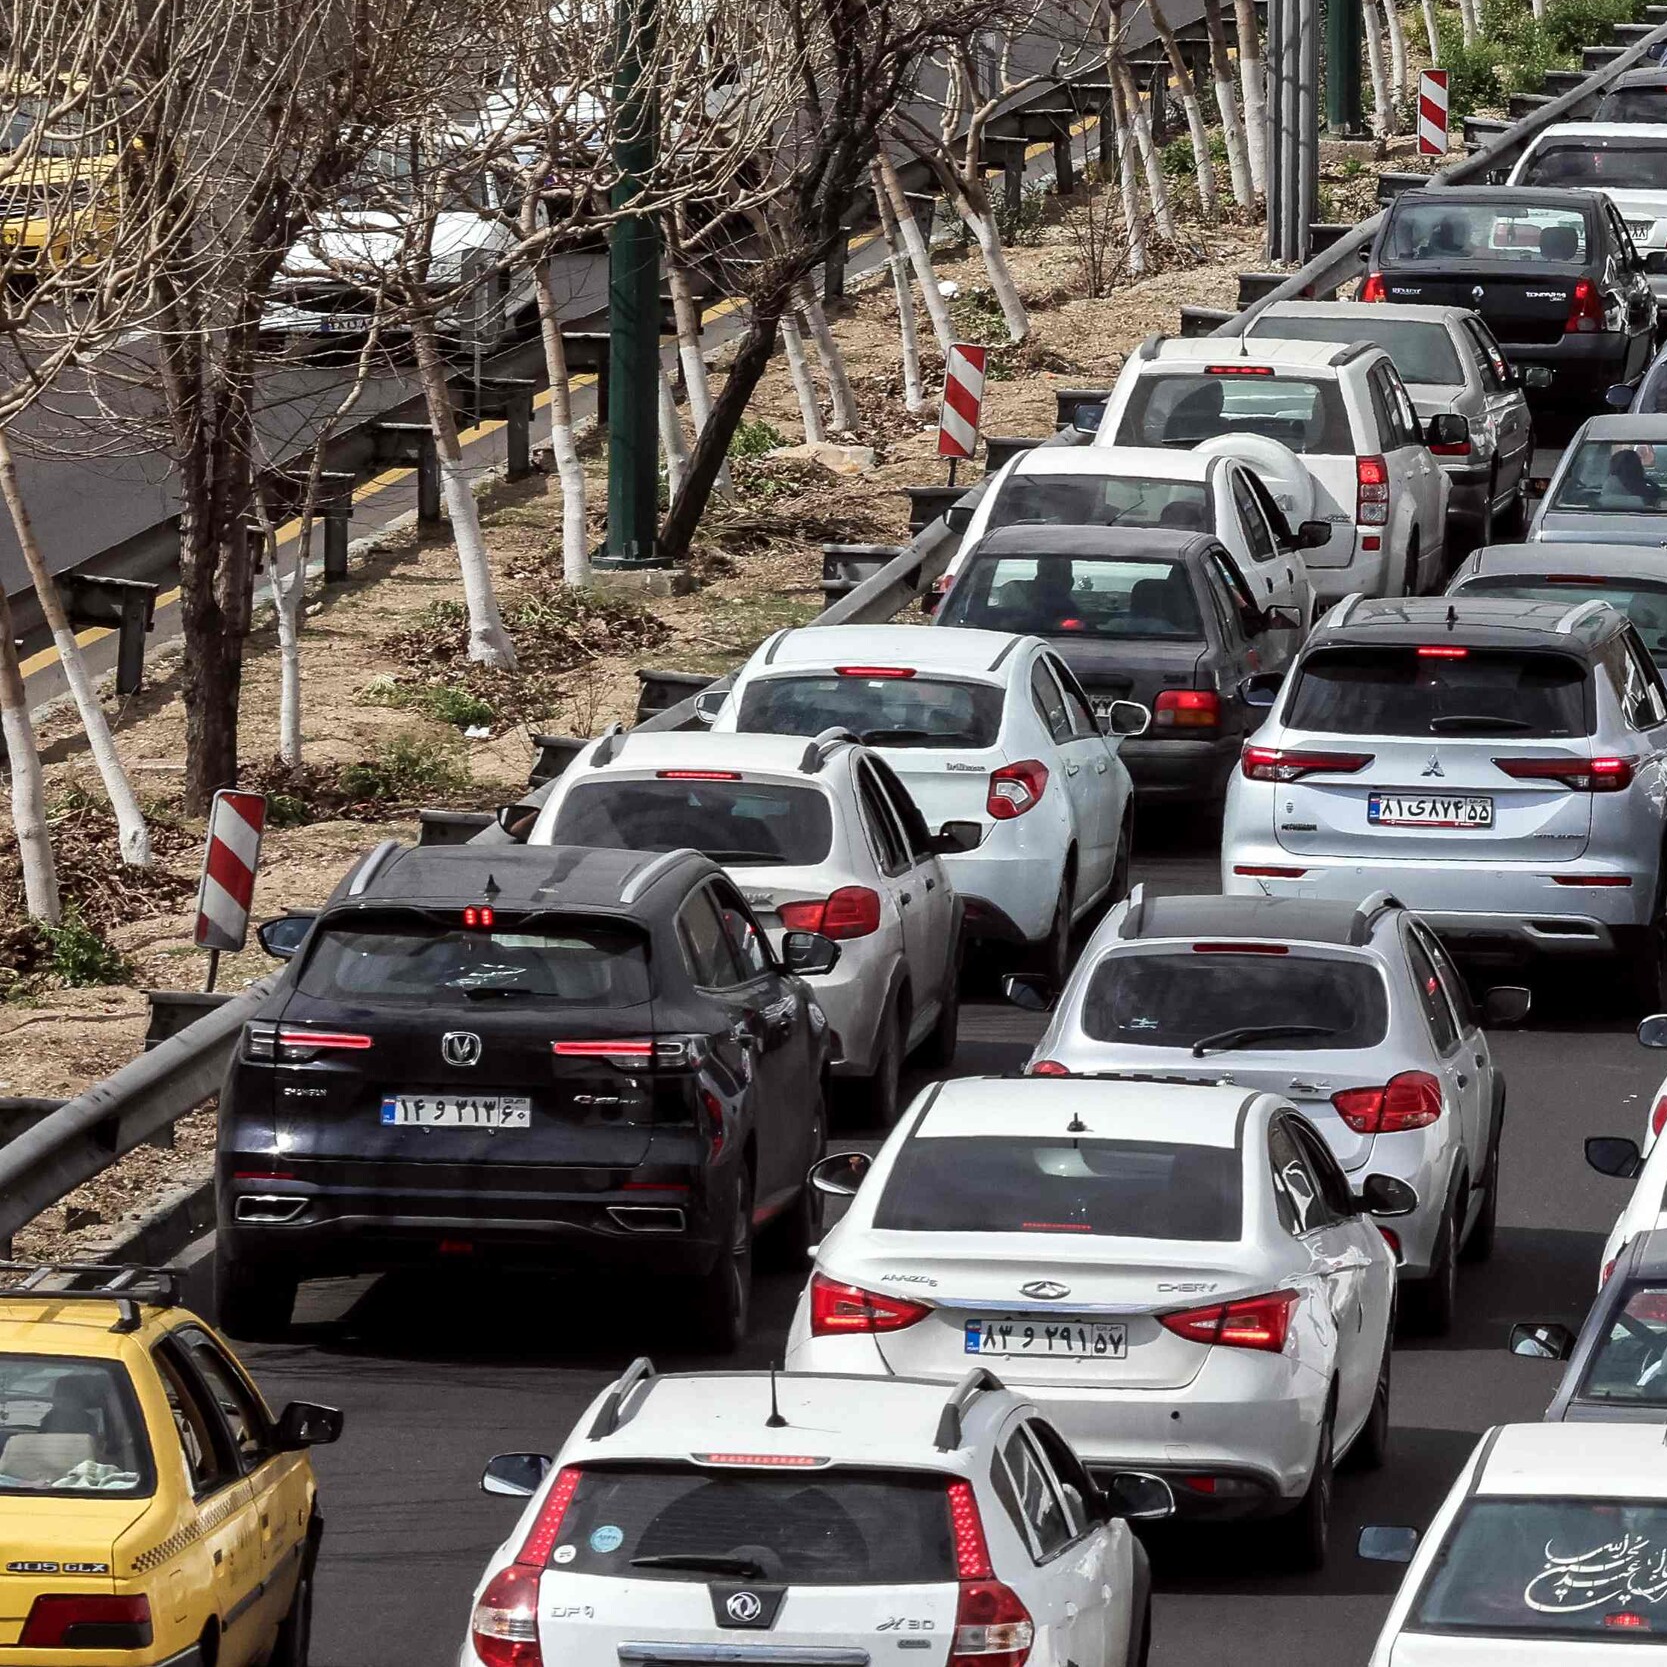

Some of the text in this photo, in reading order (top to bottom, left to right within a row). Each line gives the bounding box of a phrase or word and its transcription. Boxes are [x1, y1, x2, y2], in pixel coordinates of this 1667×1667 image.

[1157, 1282, 1218, 1293] CHERY
[7, 1561, 106, 1573] 405 GLX
